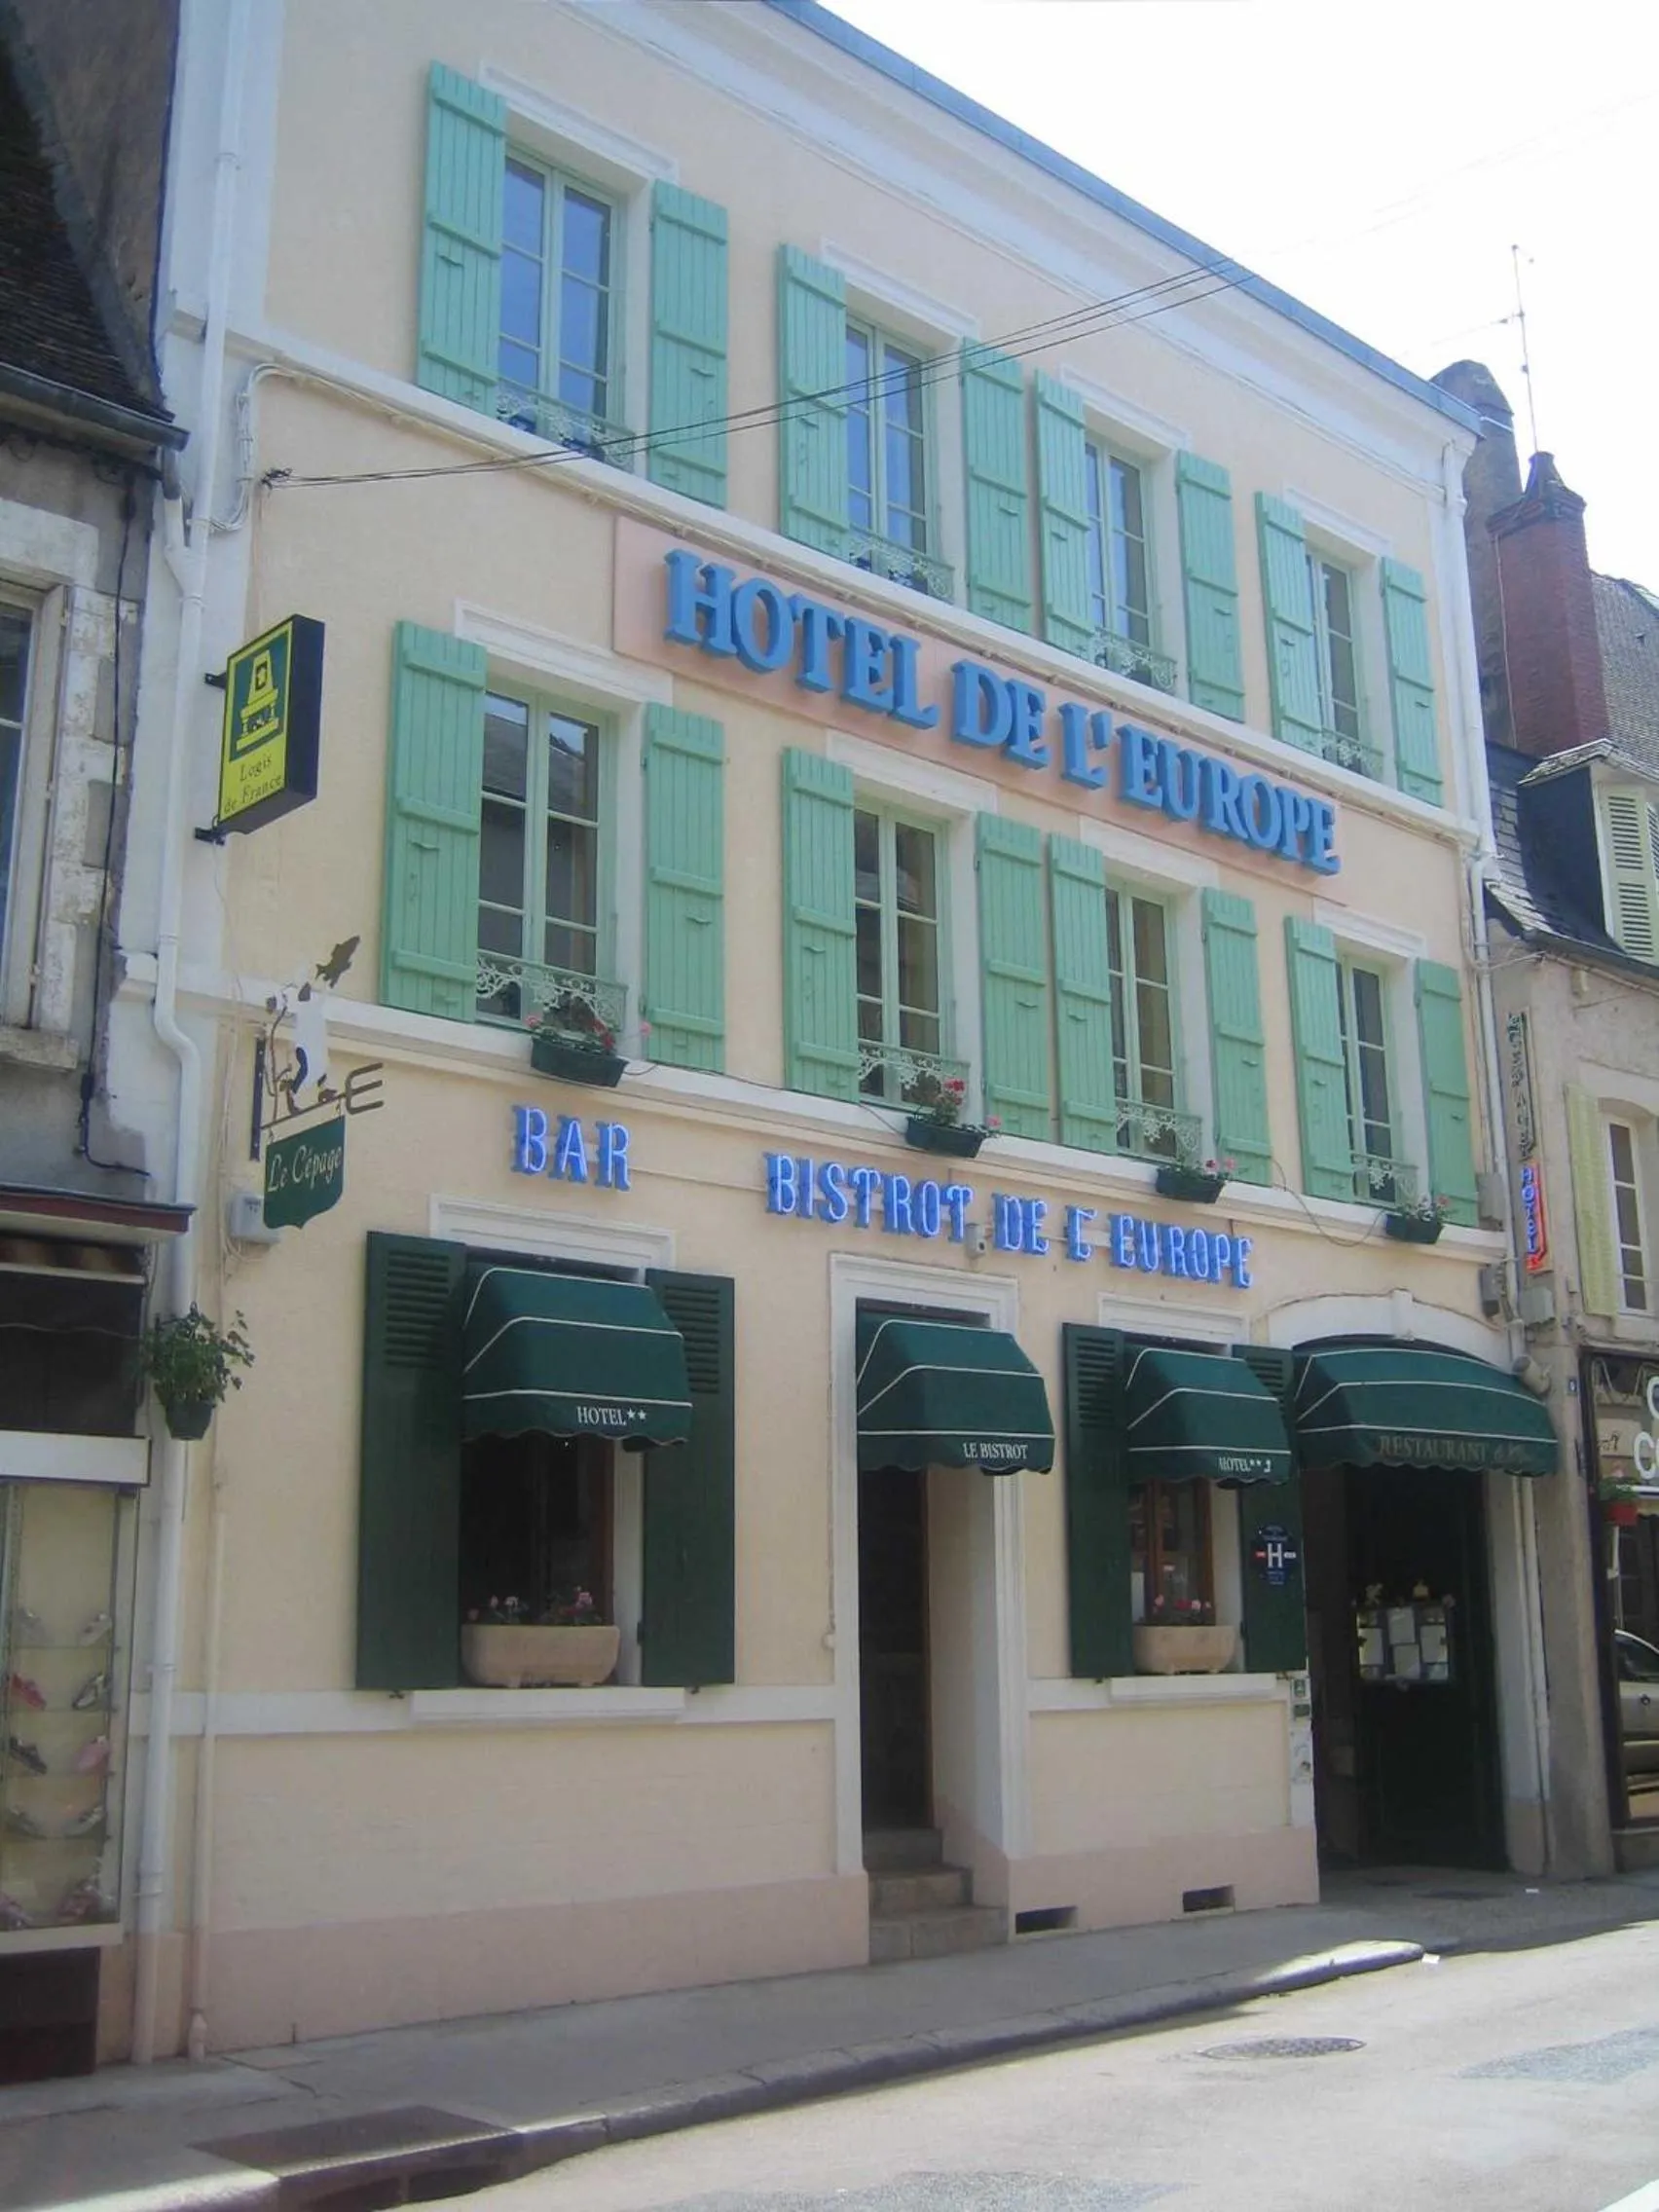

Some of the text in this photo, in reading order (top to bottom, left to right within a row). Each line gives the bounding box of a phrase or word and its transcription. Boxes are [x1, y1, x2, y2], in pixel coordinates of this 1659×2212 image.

[664, 548, 1342, 876] HOTEL DE L'EUROPE
[240, 753, 272, 782] Logis
[241, 774, 282, 804] France
[267, 1144, 343, 1192] Le Cépage
[511, 1105, 631, 1193] BAR
[764, 1152, 974, 1244] BISTROT
[992, 1192, 1050, 1256] DE
[576, 1405, 627, 1426] HOTEL
[962, 1441, 1029, 1459] LE BISTROT
[1379, 1434, 1491, 1460] RESTAURANT
[1218, 1456, 1251, 1473] HOTEL
[1267, 1541, 1283, 1568] H
